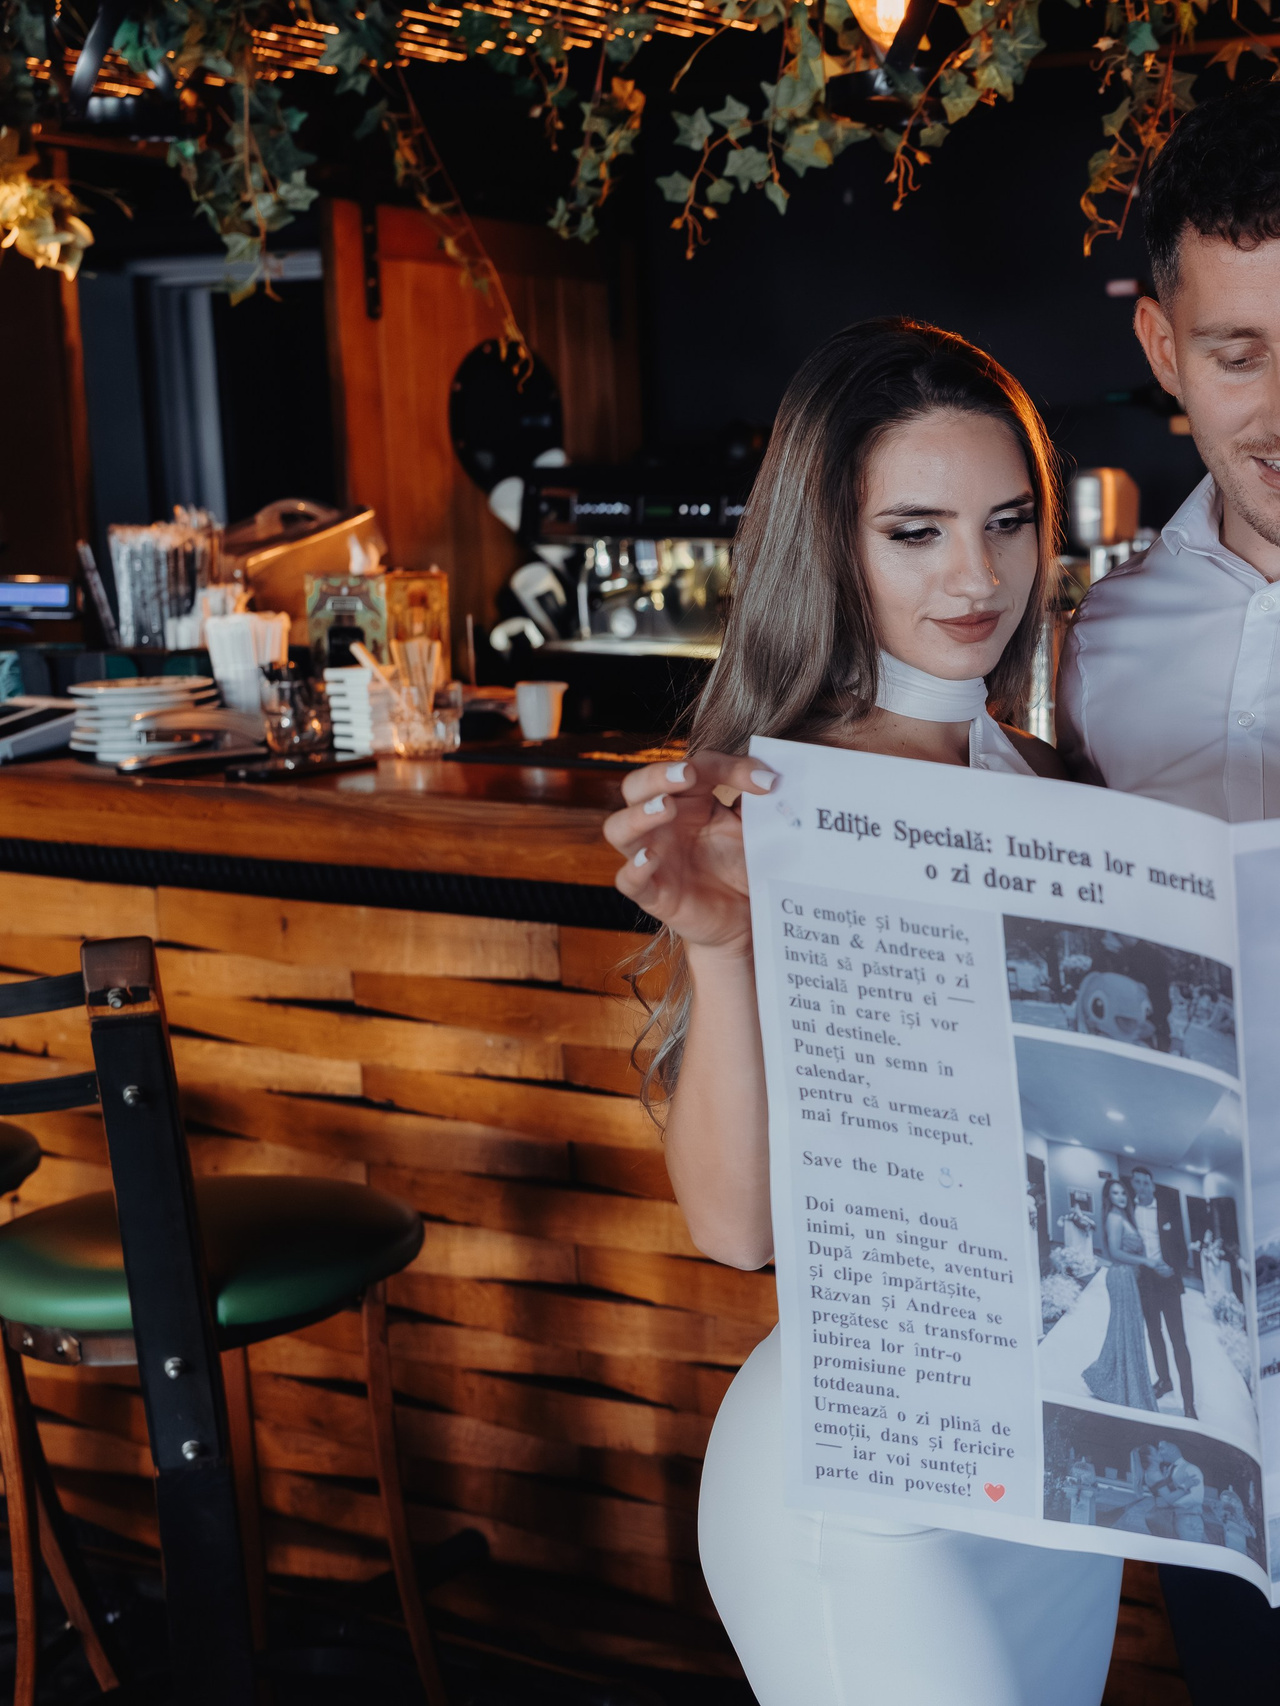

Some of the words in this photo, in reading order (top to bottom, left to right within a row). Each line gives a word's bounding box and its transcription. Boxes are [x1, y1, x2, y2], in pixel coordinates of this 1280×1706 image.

[894, 820, 992, 853] Specială:
[1006, 835, 1092, 868] Iubirea
[1104, 851, 1135, 877] lor
[1148, 867, 1216, 900] merită
[925, 864, 938, 880] o
[951, 863, 971, 884] zi
[983, 867, 1036, 893] doar
[1051, 882, 1064, 897] a
[1077, 882, 1104, 904] ei!
[781, 898, 804, 916] Cu
[899, 917, 969, 944] bucurie,
[783, 922, 840, 946] Răzvan
[849, 933, 865, 950] &
[875, 938, 946, 962] Andreea
[955, 952, 974, 966] vă
[784, 945, 828, 967] invită
[837, 957, 853, 971] să
[935, 974, 946, 985] o
[955, 974, 969, 989] zi
[787, 973, 848, 993] specială
[857, 985, 913, 1003] pentru
[923, 991, 937, 1006] ei
[789, 993, 821, 1012] ziua
[830, 999, 846, 1016] în
[855, 1007, 891, 1023] care
[930, 1018, 959, 1032] vor
[791, 1018, 816, 1034] uni
[825, 1022, 901, 1046] destinele.
[795, 1063, 871, 1088] calendar,
[854, 1052, 876, 1065] un
[885, 1056, 928, 1073] semn
[937, 1060, 954, 1077] în
[798, 1086, 853, 1104] pentru
[862, 1095, 880, 1109] că
[888, 1101, 959, 1122] urmează
[968, 1113, 991, 1127] cel
[801, 1108, 831, 1123] mai
[840, 1110, 899, 1133] frumos
[907, 1121, 973, 1146] început.
[802, 1150, 842, 1169] Save
[852, 1157, 877, 1174] the
[886, 1161, 924, 1182] Date
[804, 1195, 835, 1213] Doi
[844, 1203, 910, 1225] oameni,
[919, 1211, 958, 1231] două
[806, 1218, 855, 1240] inimi,
[865, 1228, 886, 1241] un
[896, 1230, 948, 1252] singur
[958, 1240, 1008, 1262] drum.
[807, 1240, 853, 1262] După
[862, 1247, 935, 1273] zâmbete,
[944, 1263, 1014, 1284] aventuri
[833, 1266, 873, 1286] clipe
[810, 1284, 871, 1306] Răzvan
[906, 1297, 977, 1321] Andreea
[986, 1313, 1003, 1325] se
[811, 1310, 889, 1330] pregătesc
[898, 1319, 915, 1334] să
[924, 1322, 1018, 1349] transforme
[813, 1328, 871, 1350] iubirea
[881, 1337, 905, 1354] lor
[914, 1342, 962, 1363] într-o
[813, 1355, 907, 1377] promisiune
[915, 1369, 971, 1387] pentru
[813, 1374, 900, 1399] totdeauna.
[813, 1395, 888, 1419] Urmează
[897, 1411, 906, 1422] o
[915, 1411, 930, 1426] zi
[940, 1415, 982, 1433] plină
[991, 1421, 1011, 1437] de
[853, 1445, 877, 1462] iar
[886, 1452, 911, 1467] voi
[880, 1427, 919, 1447] dans
[953, 1437, 1015, 1459] fericire
[815, 1465, 859, 1481] parte
[868, 1469, 895, 1486] din
[904, 1478, 971, 1497] poveste!
